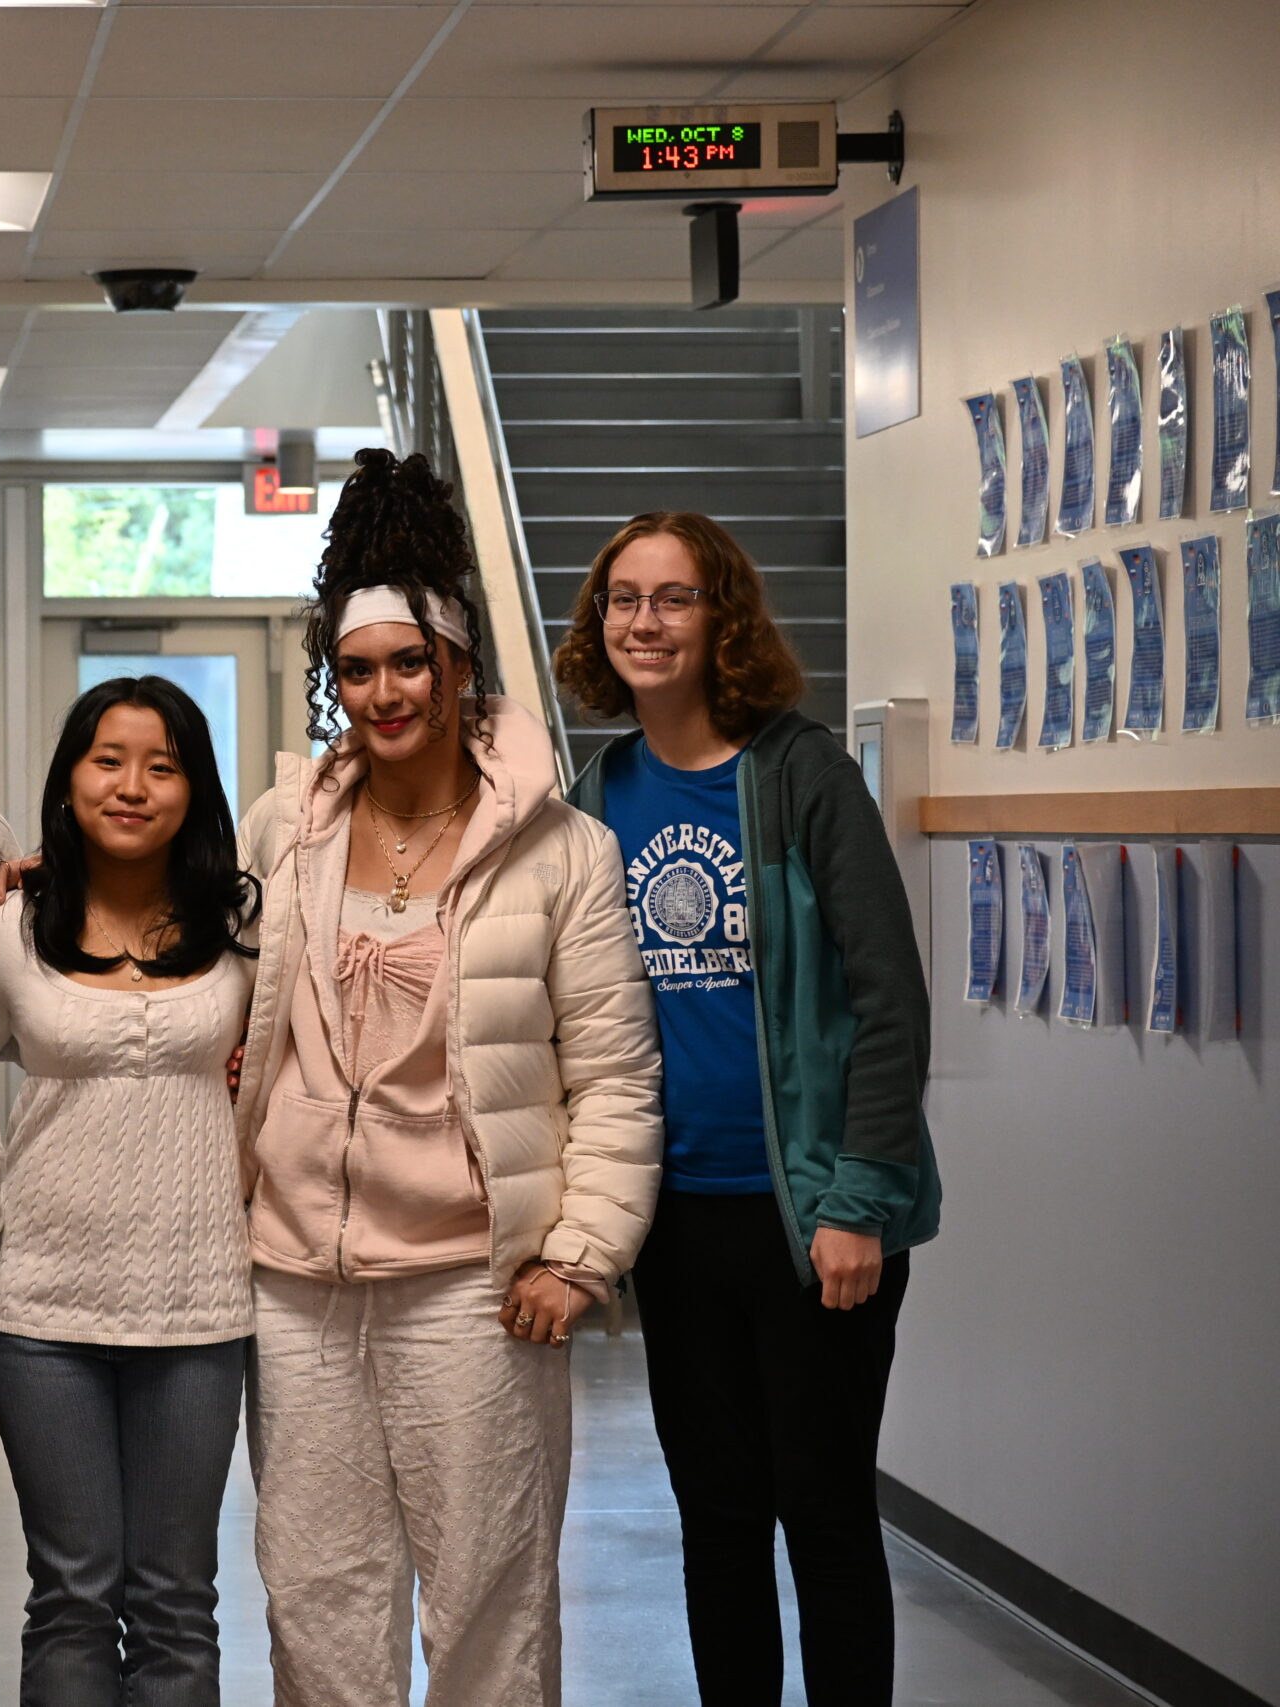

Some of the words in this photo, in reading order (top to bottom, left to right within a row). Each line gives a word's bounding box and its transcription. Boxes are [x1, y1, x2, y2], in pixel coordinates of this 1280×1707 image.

[680, 126, 721, 142] OCT
[732, 126, 744, 141] 8
[642, 145, 699, 169] 1:43
[706, 144, 735, 160] PM
[641, 947, 754, 977] EIDELBER
[657, 977, 693, 993] Semper
[695, 976, 739, 992] Apertus
